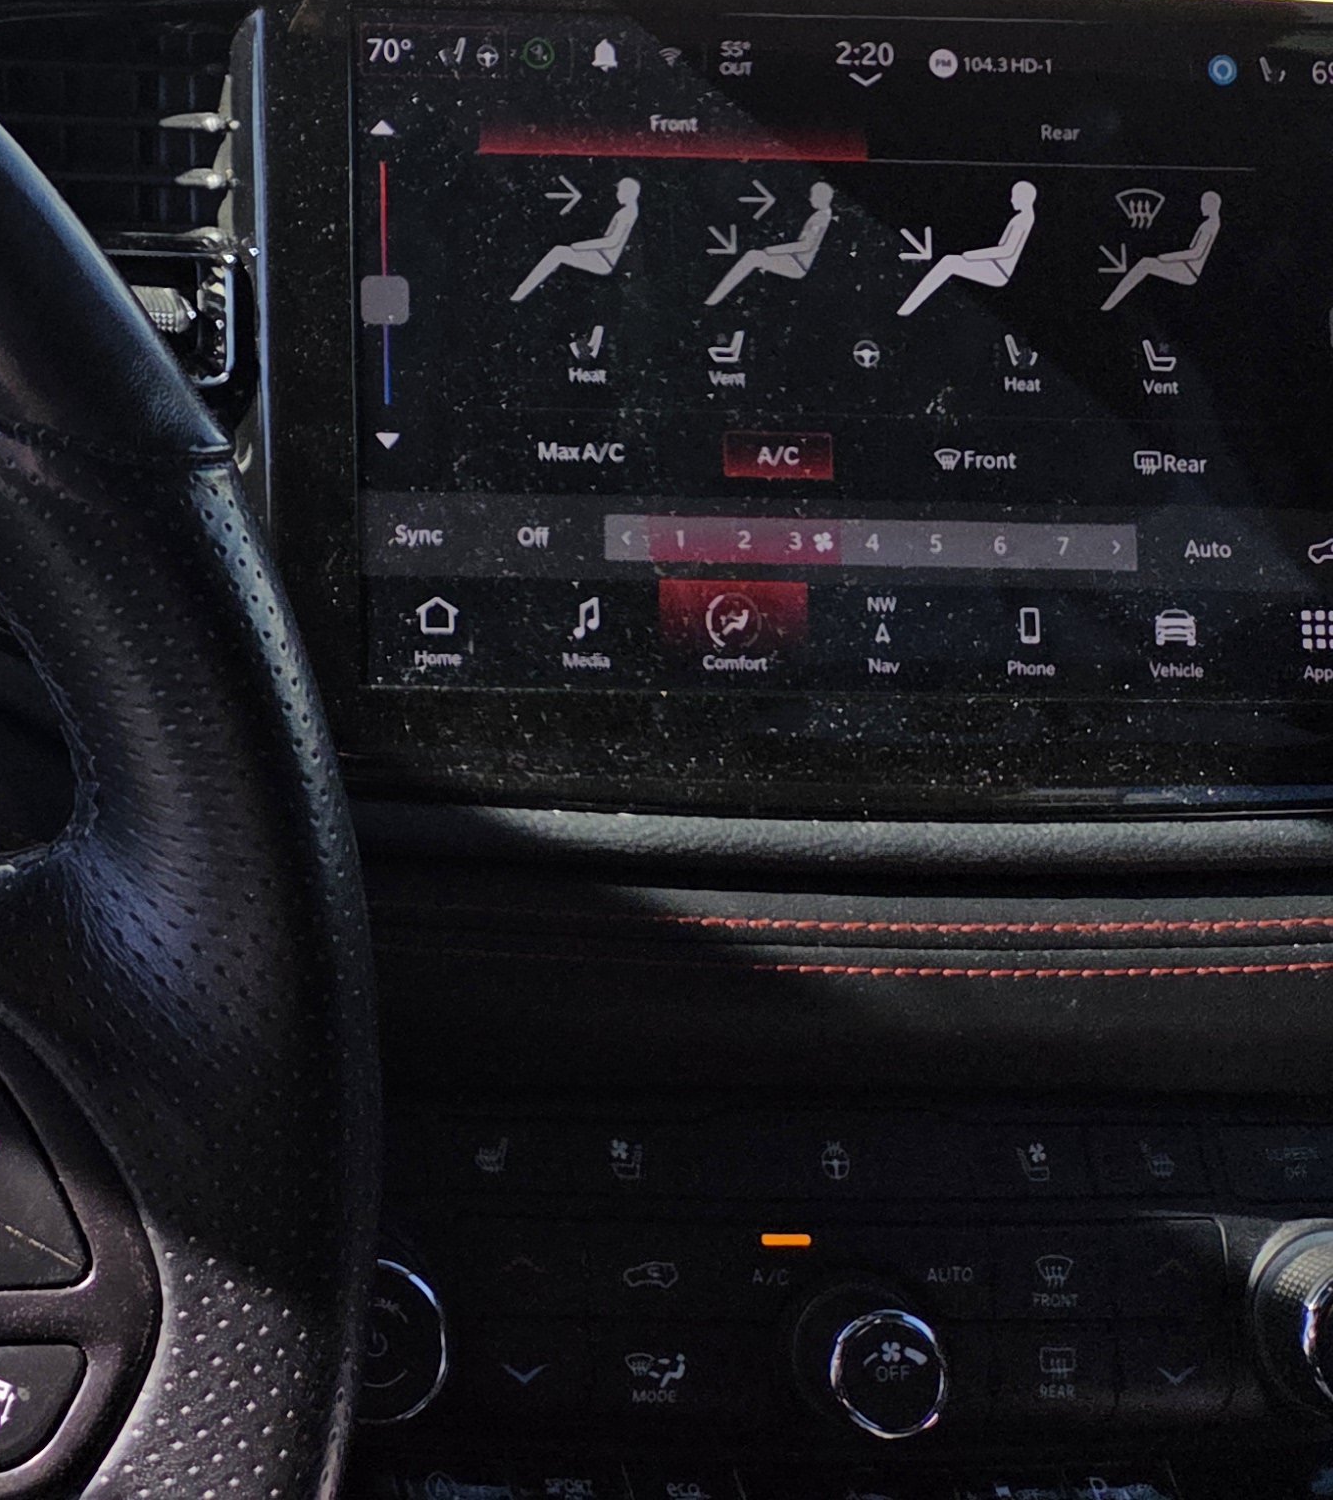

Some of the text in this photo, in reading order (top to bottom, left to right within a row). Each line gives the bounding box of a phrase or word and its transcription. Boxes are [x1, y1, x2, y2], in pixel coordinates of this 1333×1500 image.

[366, 37, 412, 64] 70°
[835, 41, 894, 67] 2:20
[719, 60, 753, 76] OUT
[935, 58, 952, 68] FM
[963, 56, 1052, 74] 104.3 HD-1
[649, 113, 698, 134] Front
[1040, 124, 1081, 142] Rear
[568, 366, 607, 385] Heat
[708, 369, 747, 388] Vent
[1004, 375, 1041, 393] Heat
[1142, 378, 1179, 395] Vent
[536, 442, 626, 463] Max A/C
[756, 446, 801, 467] A/C
[963, 450, 1017, 470] Front
[1163, 454, 1208, 475] Rear
[394, 524, 444, 547] Sync
[517, 526, 550, 548] Off
[675, 530, 1070, 556] 1 2 3 4 5 6 7
[1184, 539, 1232, 559] Auto
[866, 596, 897, 614] NW
[413, 650, 463, 667] Home
[562, 652, 611, 670] Media
[702, 654, 768, 672] Comfort
[867, 658, 901, 675] Nav
[1006, 659, 1056, 677] Phone
[1149, 662, 1204, 680] Vehicle
[752, 1268, 790, 1286] A/C
[926, 1267, 975, 1283] AUTO
[1033, 1293, 1079, 1308] FRONT
[875, 1365, 911, 1383] OFF
[1038, 1384, 1075, 1399] REAR
